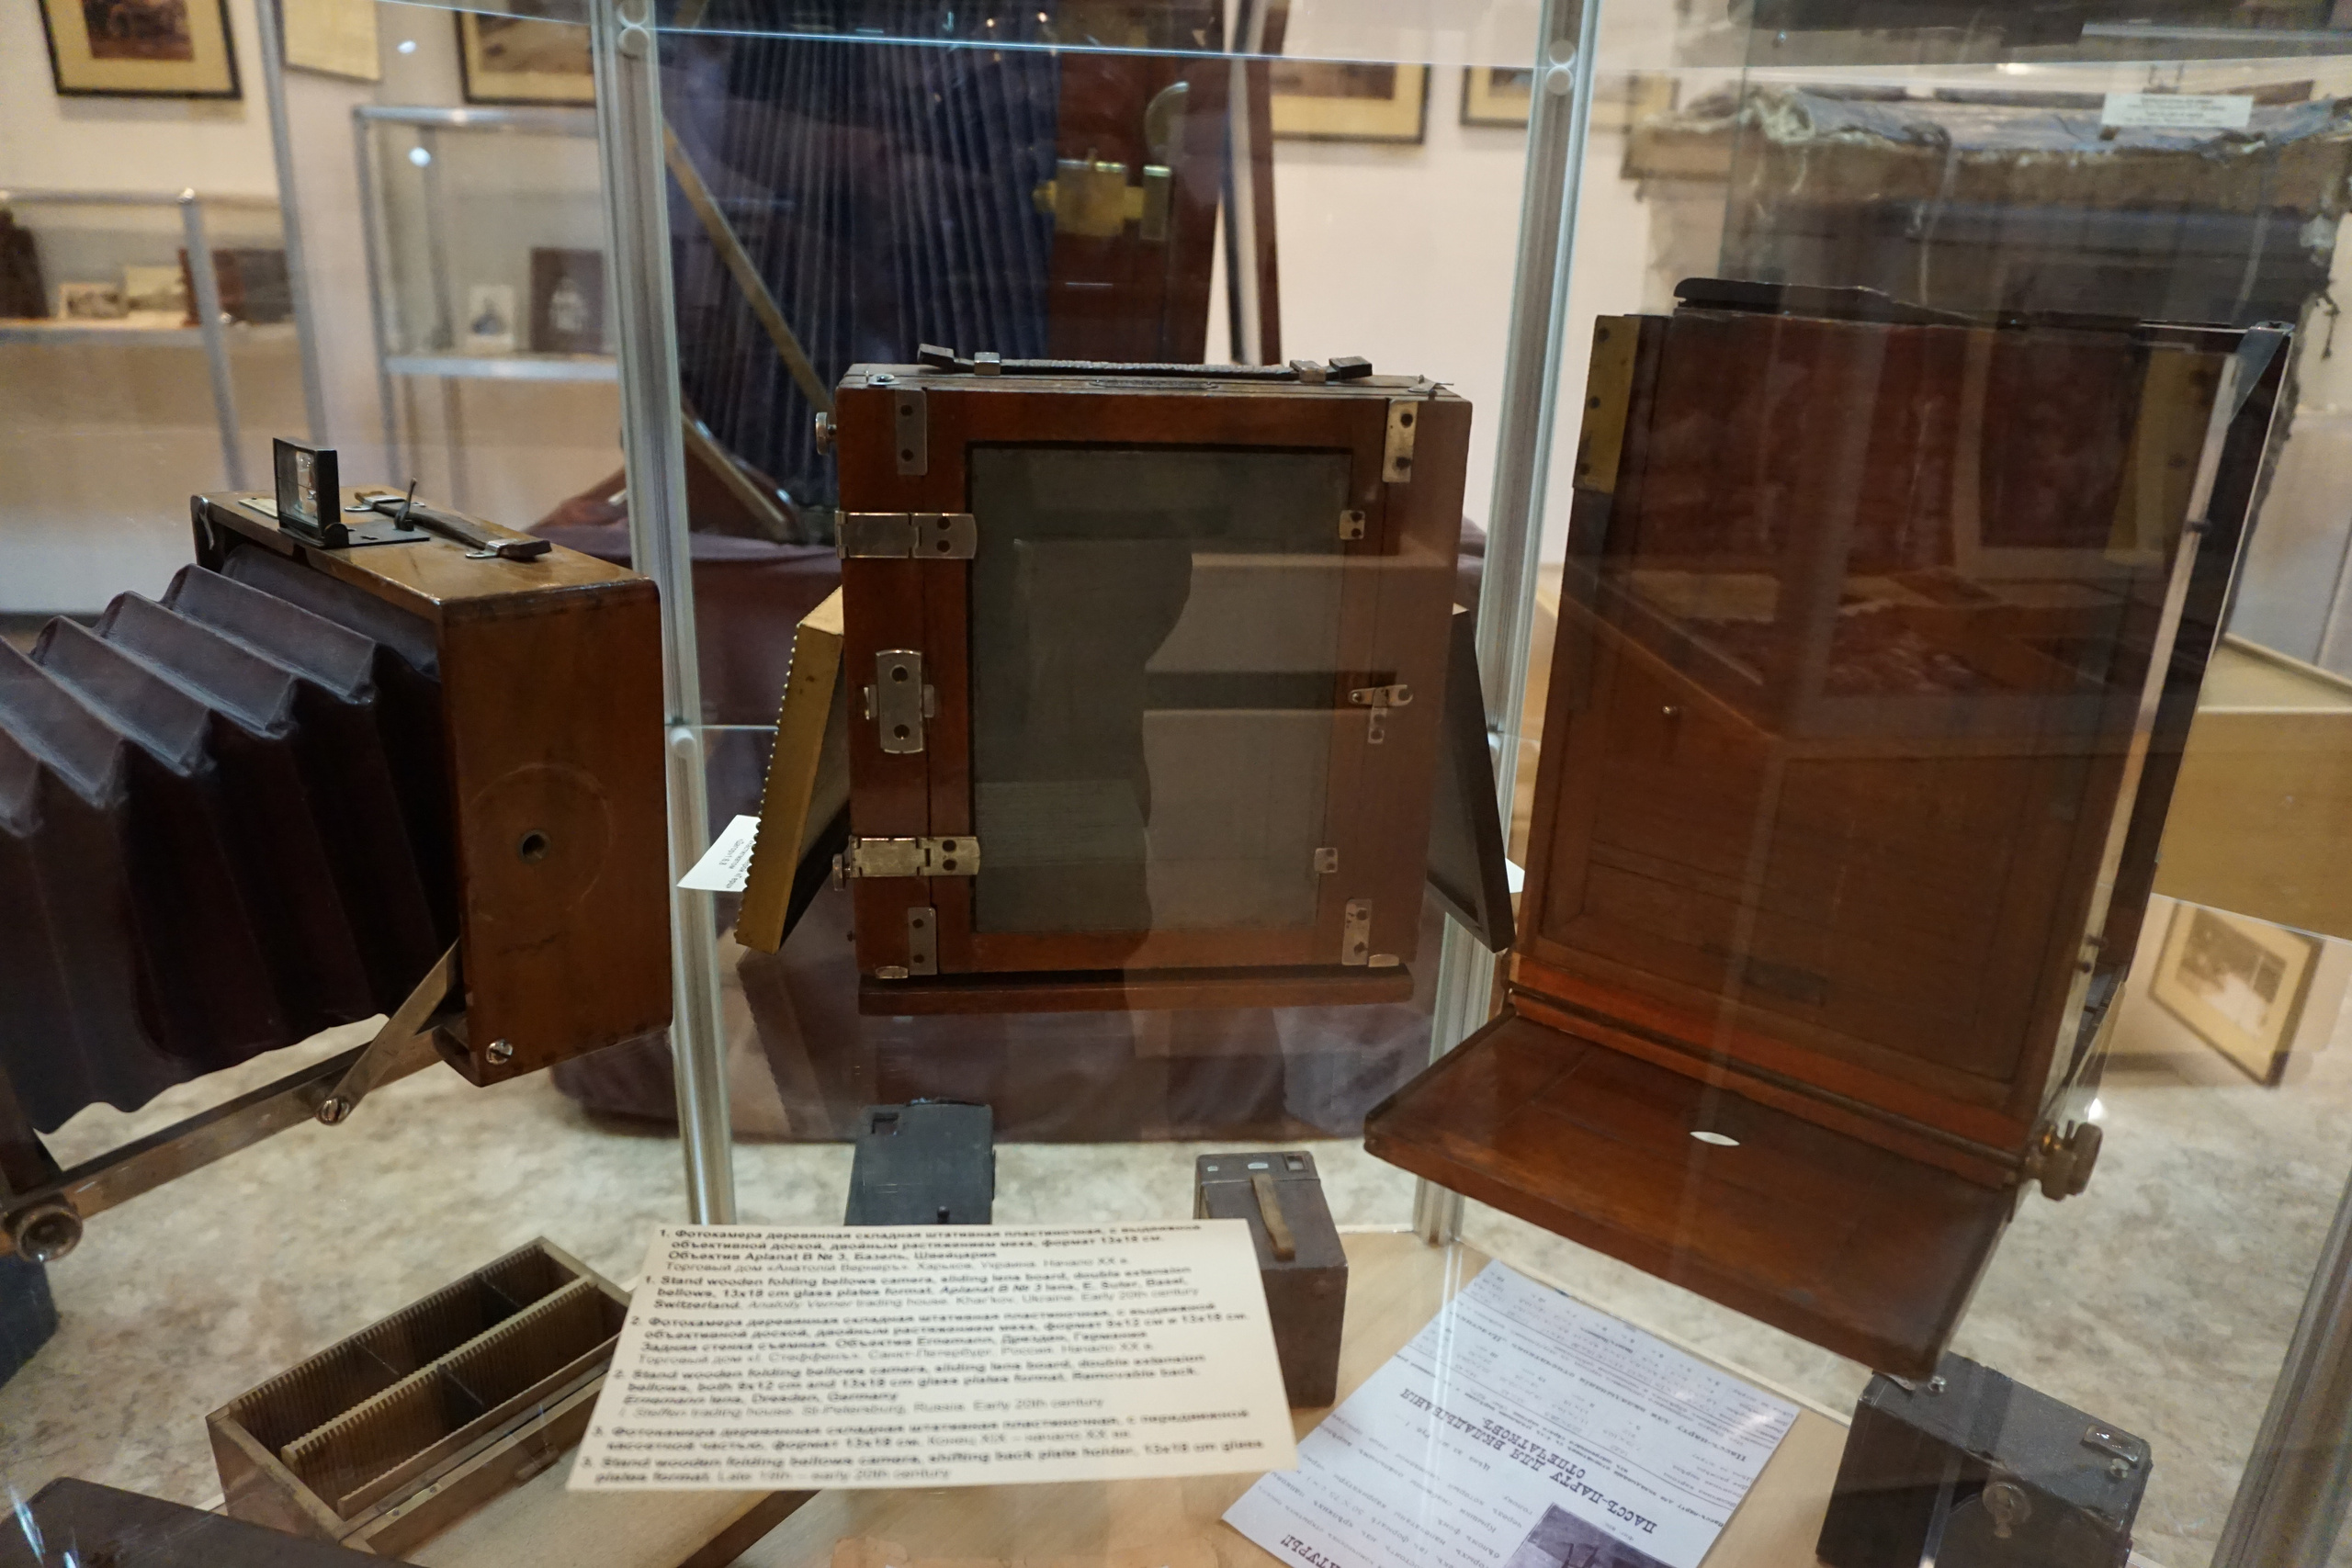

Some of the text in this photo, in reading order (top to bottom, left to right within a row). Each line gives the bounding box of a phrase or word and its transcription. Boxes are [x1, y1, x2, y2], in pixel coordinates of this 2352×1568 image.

[673, 1229, 763, 1239] Фотокамера
[670, 1239, 767, 1249] объективной
[667, 1251, 741, 1259] Объектив
[744, 1251, 798, 1261] Aplanat
[660, 1276, 704, 1284] Stand
[706, 1276, 763, 1284] wooden
[767, 1276, 817, 1286] folding
[1509, 1447, 1545, 1472] ДЛЯ
[1548, 1468, 1657, 1534] ПАССЪ-ПАРТУ
